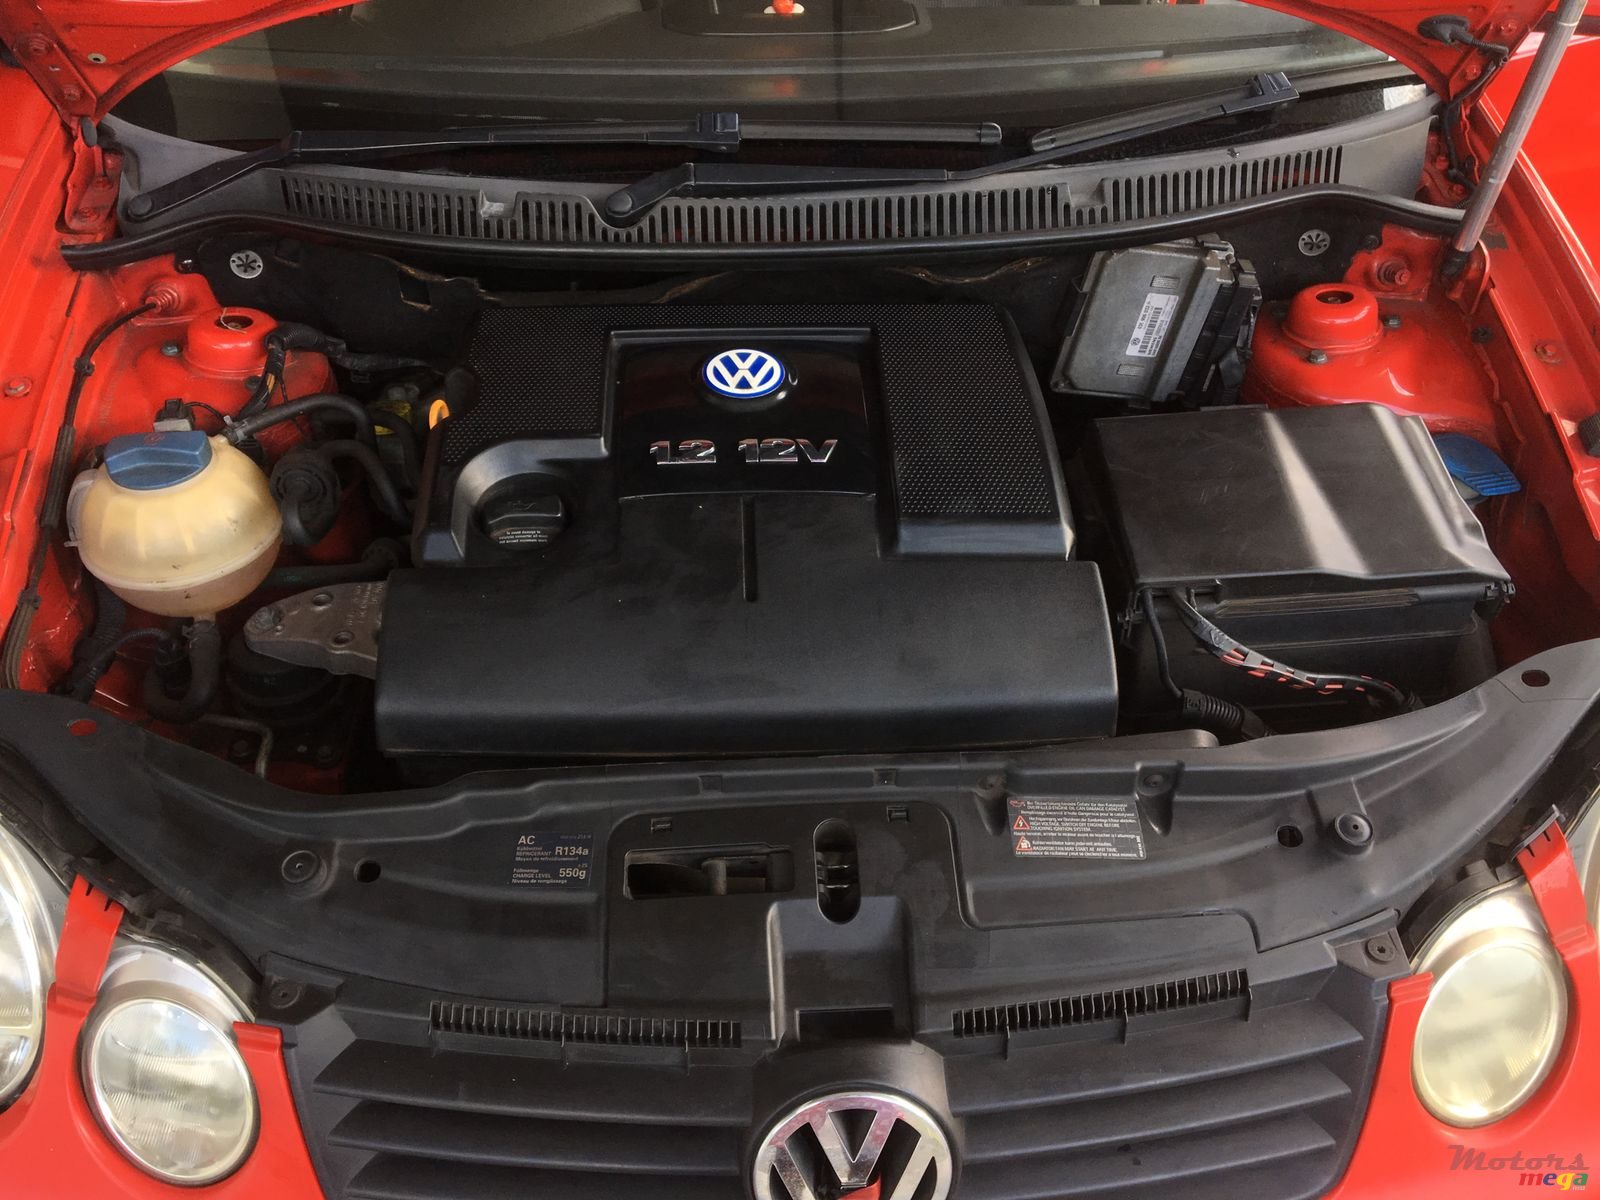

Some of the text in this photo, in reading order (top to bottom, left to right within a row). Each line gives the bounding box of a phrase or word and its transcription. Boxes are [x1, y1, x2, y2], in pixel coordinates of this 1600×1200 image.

[738, 438, 838, 463] 12V
[518, 835, 536, 845] AC
[555, 846, 589, 856] R134a
[559, 867, 587, 880] 550g
